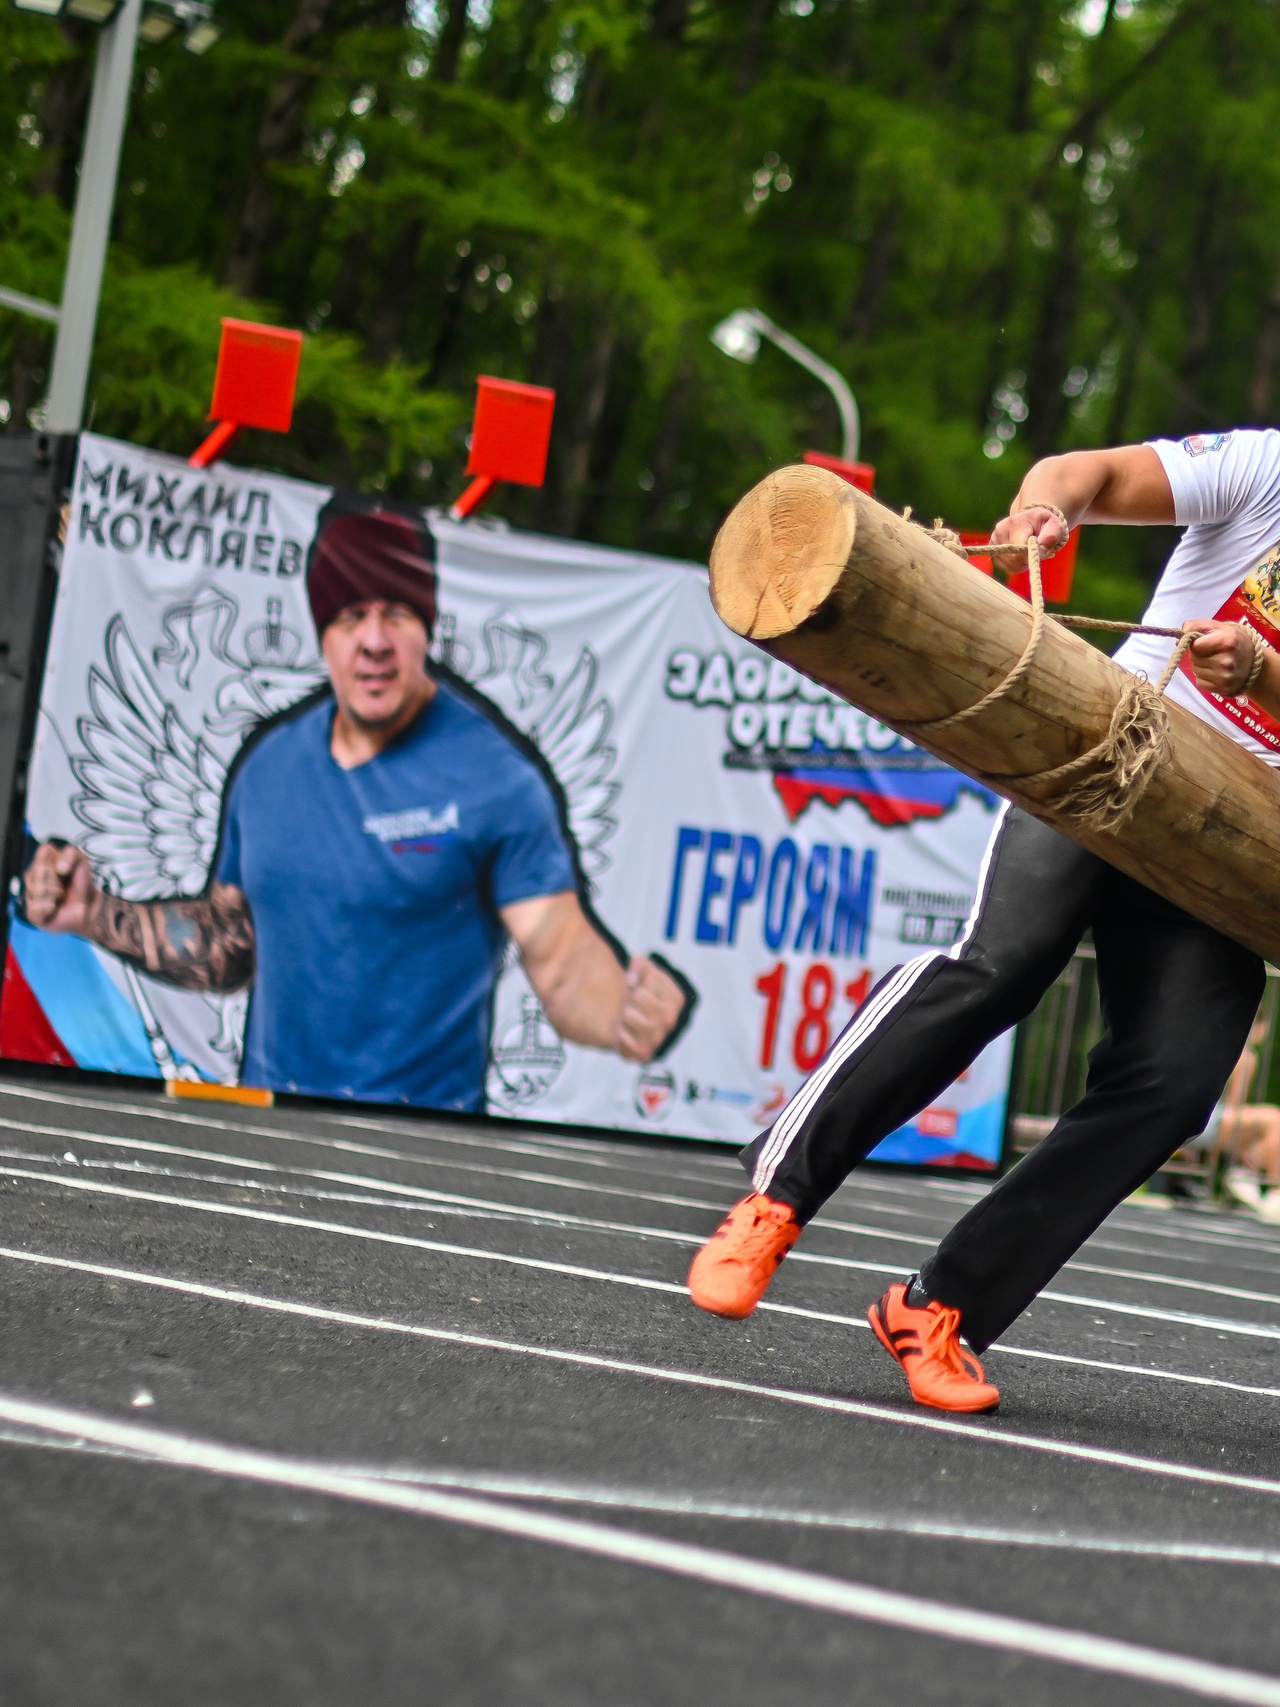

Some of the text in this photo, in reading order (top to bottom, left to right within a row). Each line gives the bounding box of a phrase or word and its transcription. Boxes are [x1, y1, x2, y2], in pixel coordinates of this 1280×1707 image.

[79, 459, 272, 526] МИХАИЛ
[79, 502, 303, 578] КОКЛЯЕВ
[664, 826, 878, 958] ГЕРОЯМ
